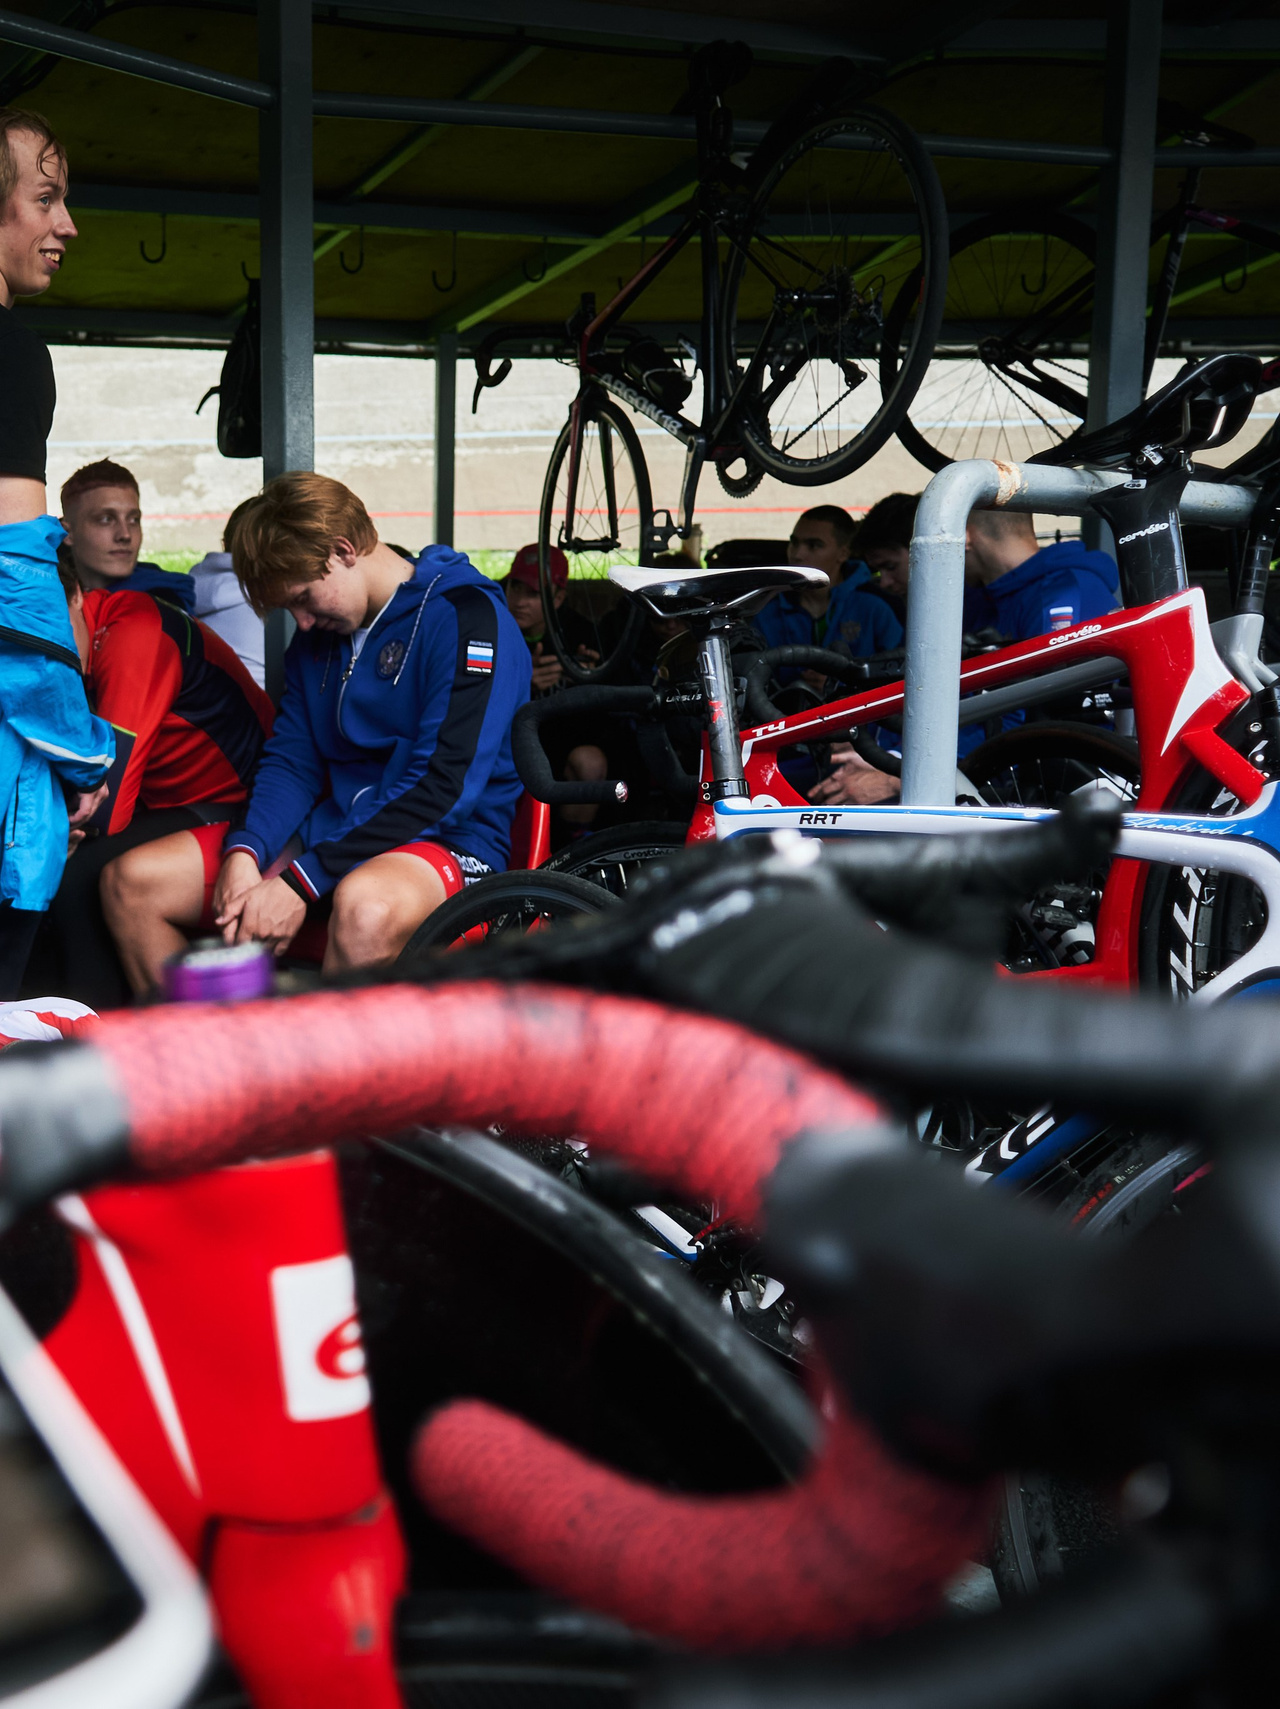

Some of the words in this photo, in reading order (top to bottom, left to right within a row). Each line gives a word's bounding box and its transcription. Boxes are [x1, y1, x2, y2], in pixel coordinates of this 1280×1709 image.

[599, 372, 665, 422] ARGON
[661, 414, 683, 435] 18
[1049, 624, 1102, 645] cervélo
[751, 720, 786, 737] T4
[799, 813, 843, 825] RRT
